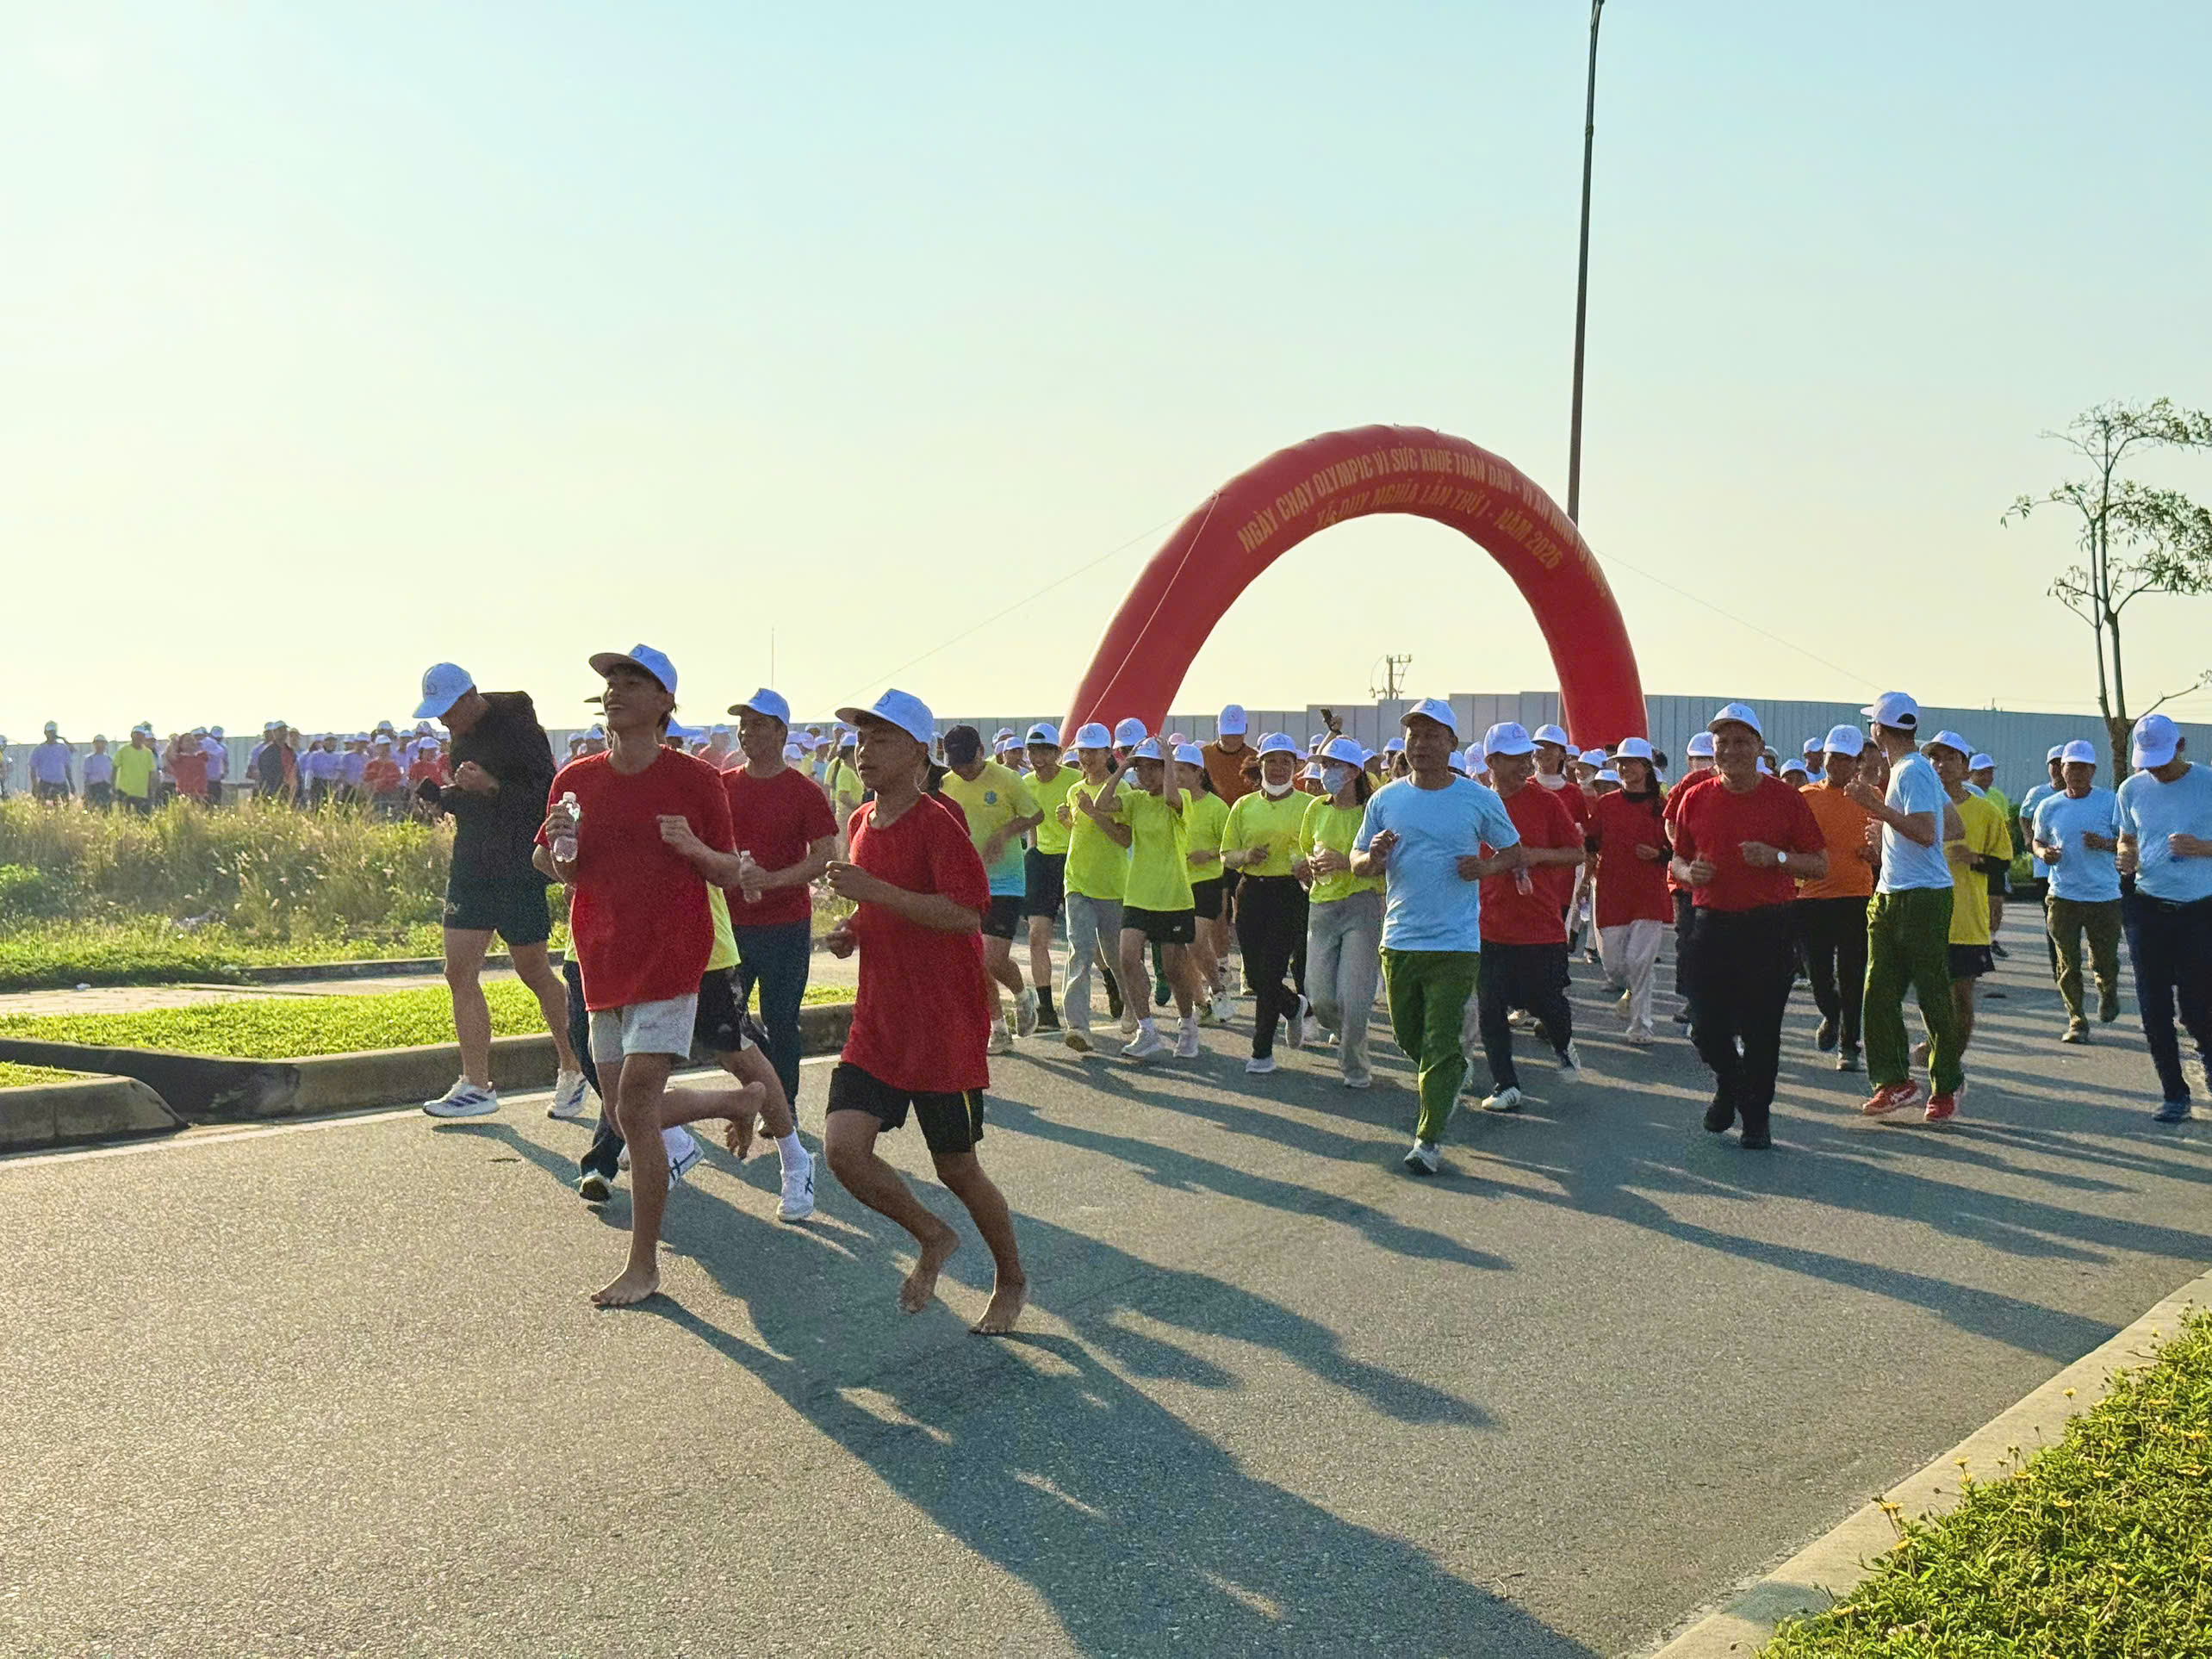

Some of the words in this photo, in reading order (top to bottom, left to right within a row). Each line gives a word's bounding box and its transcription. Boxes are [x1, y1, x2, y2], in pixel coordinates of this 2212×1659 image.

[1237, 506, 1278, 553] NGÀY
[1313, 454, 1373, 497] OLYMPIC
[1372, 446, 1389, 475] VÌ
[1524, 531, 1563, 569] 2026
